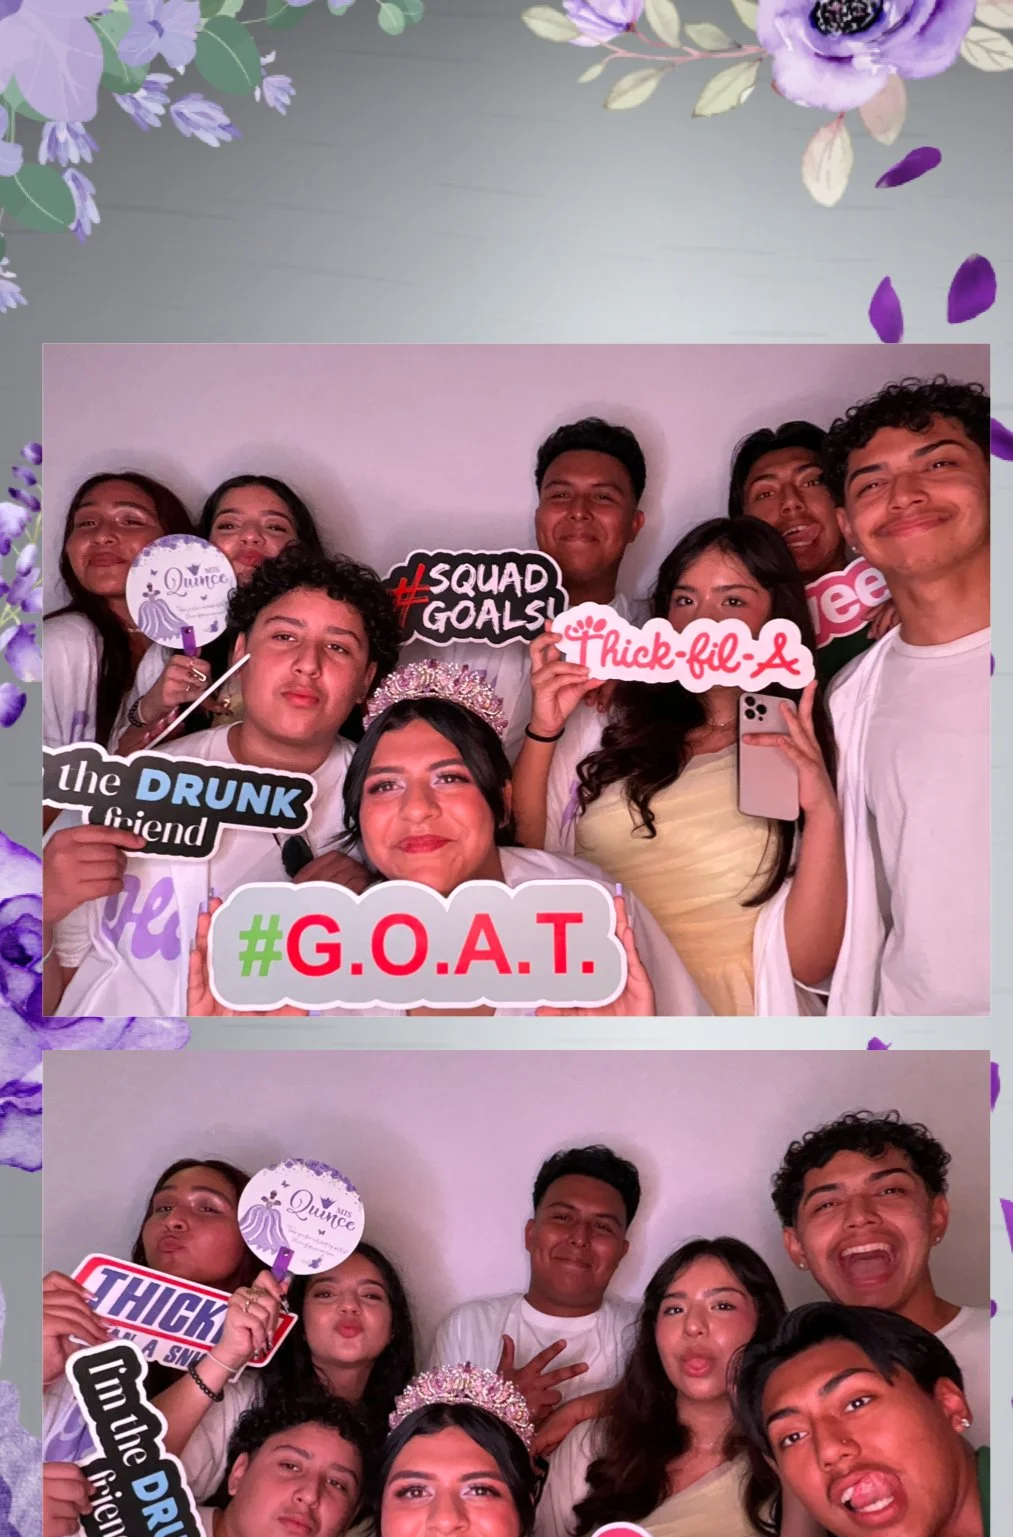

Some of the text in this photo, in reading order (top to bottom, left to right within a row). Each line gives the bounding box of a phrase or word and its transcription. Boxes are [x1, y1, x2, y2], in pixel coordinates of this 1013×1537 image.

[164, 567, 229, 597] Quince
[386, 562, 549, 628] #SQUAD
[564, 615, 801, 680] Thick-fil-A
[58, 760, 302, 819] the DRUNK
[238, 912, 595, 978] #G.O.A.T.
[286, 1188, 356, 1231] Quince
[89, 1267, 229, 1345] THICK
[142, 1339, 159, 1358] A
[88, 1358, 128, 1412] I'm
[110, 1412, 149, 1468] the
